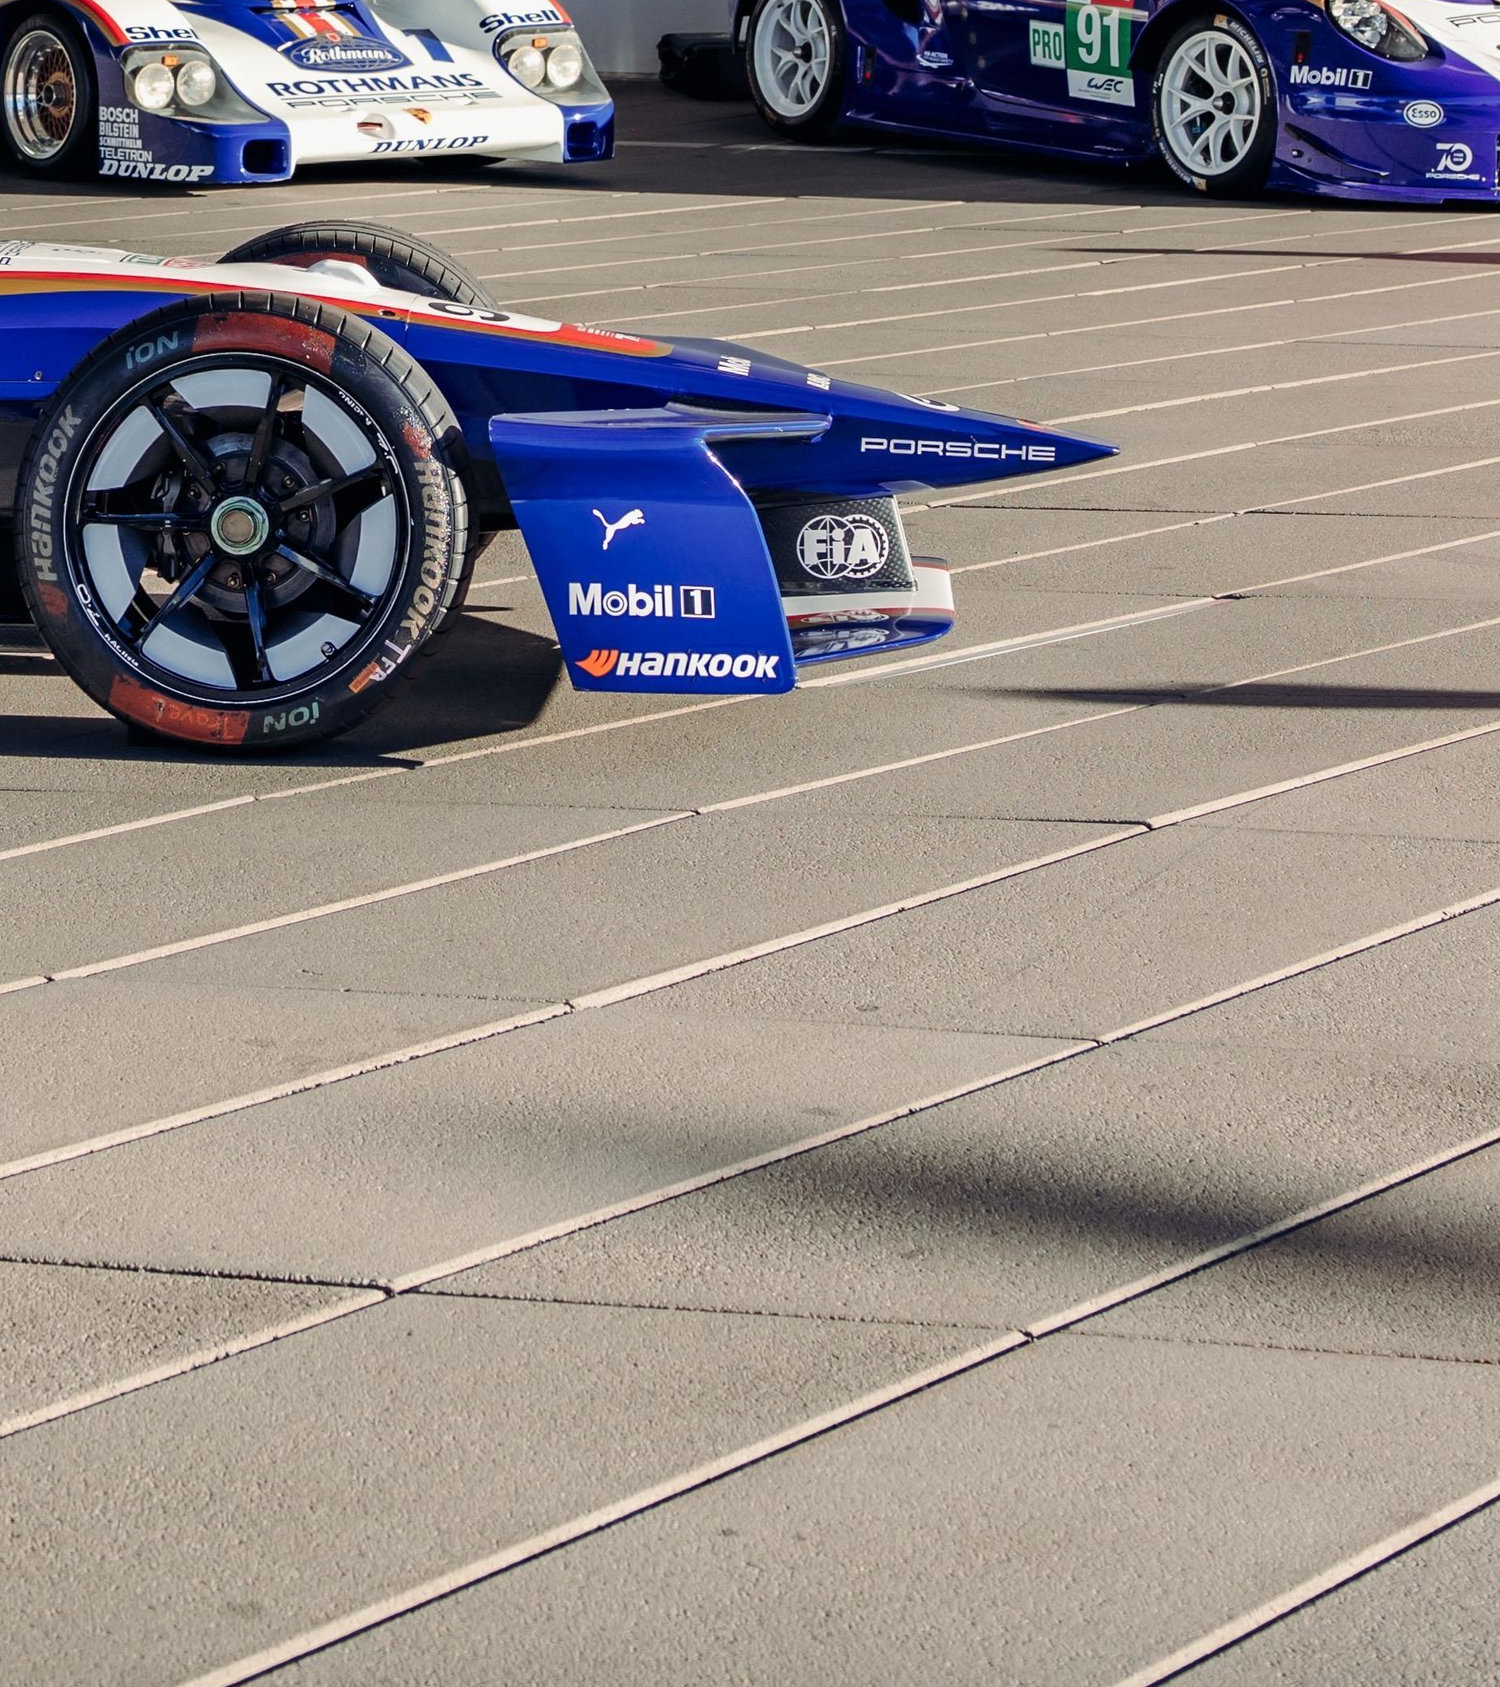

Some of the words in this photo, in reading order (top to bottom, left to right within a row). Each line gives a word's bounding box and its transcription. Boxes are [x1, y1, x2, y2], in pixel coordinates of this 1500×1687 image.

[479, 9, 561, 34] Shell
[1032, 28, 1063, 62] PRO
[1076, 5, 1120, 68] 91
[1229, 21, 1265, 64] MICHELIN
[303, 46, 400, 65] Rothmans
[266, 73, 484, 97] ROTHMANS
[1087, 77, 1124, 94] WEC
[1290, 65, 1347, 86] Mobil
[286, 91, 504, 109] PORSCHE
[99, 106, 139, 123] BOSCH
[99, 121, 139, 138] BILSTEIN
[99, 147, 152, 163] TELETRON
[368, 135, 490, 153] DUNLOP
[99, 159, 215, 182] DUNLOP
[860, 437, 1057, 462] PORSCHE
[568, 582, 673, 617] Mobil
